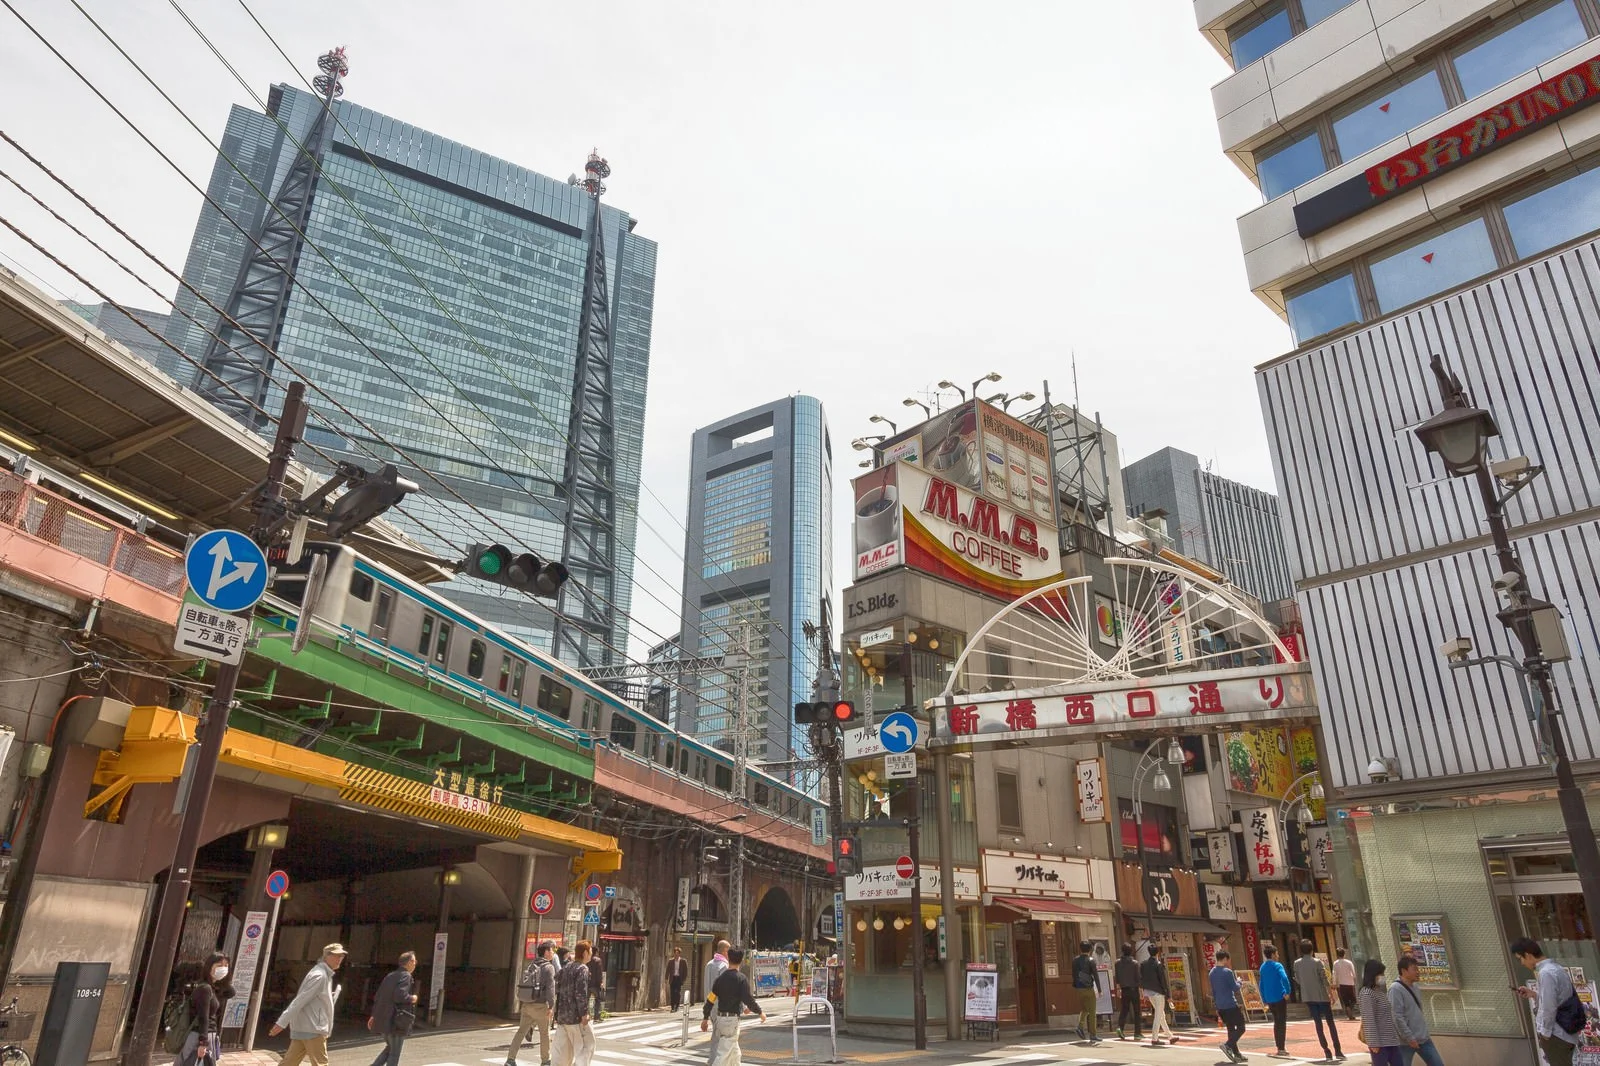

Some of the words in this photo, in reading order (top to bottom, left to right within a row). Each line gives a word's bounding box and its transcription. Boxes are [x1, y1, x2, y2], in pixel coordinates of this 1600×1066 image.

[865, 558, 889, 574] COFFEE
[953, 531, 1023, 577] COFFEE
[185, 608, 242, 634] 自転車を除く
[183, 627, 239, 648] 一方通行
[950, 675, 1285, 735] 新橋西口通り
[1083, 769, 1095, 803] ツバキ
[1416, 921, 1441, 935] 新台
